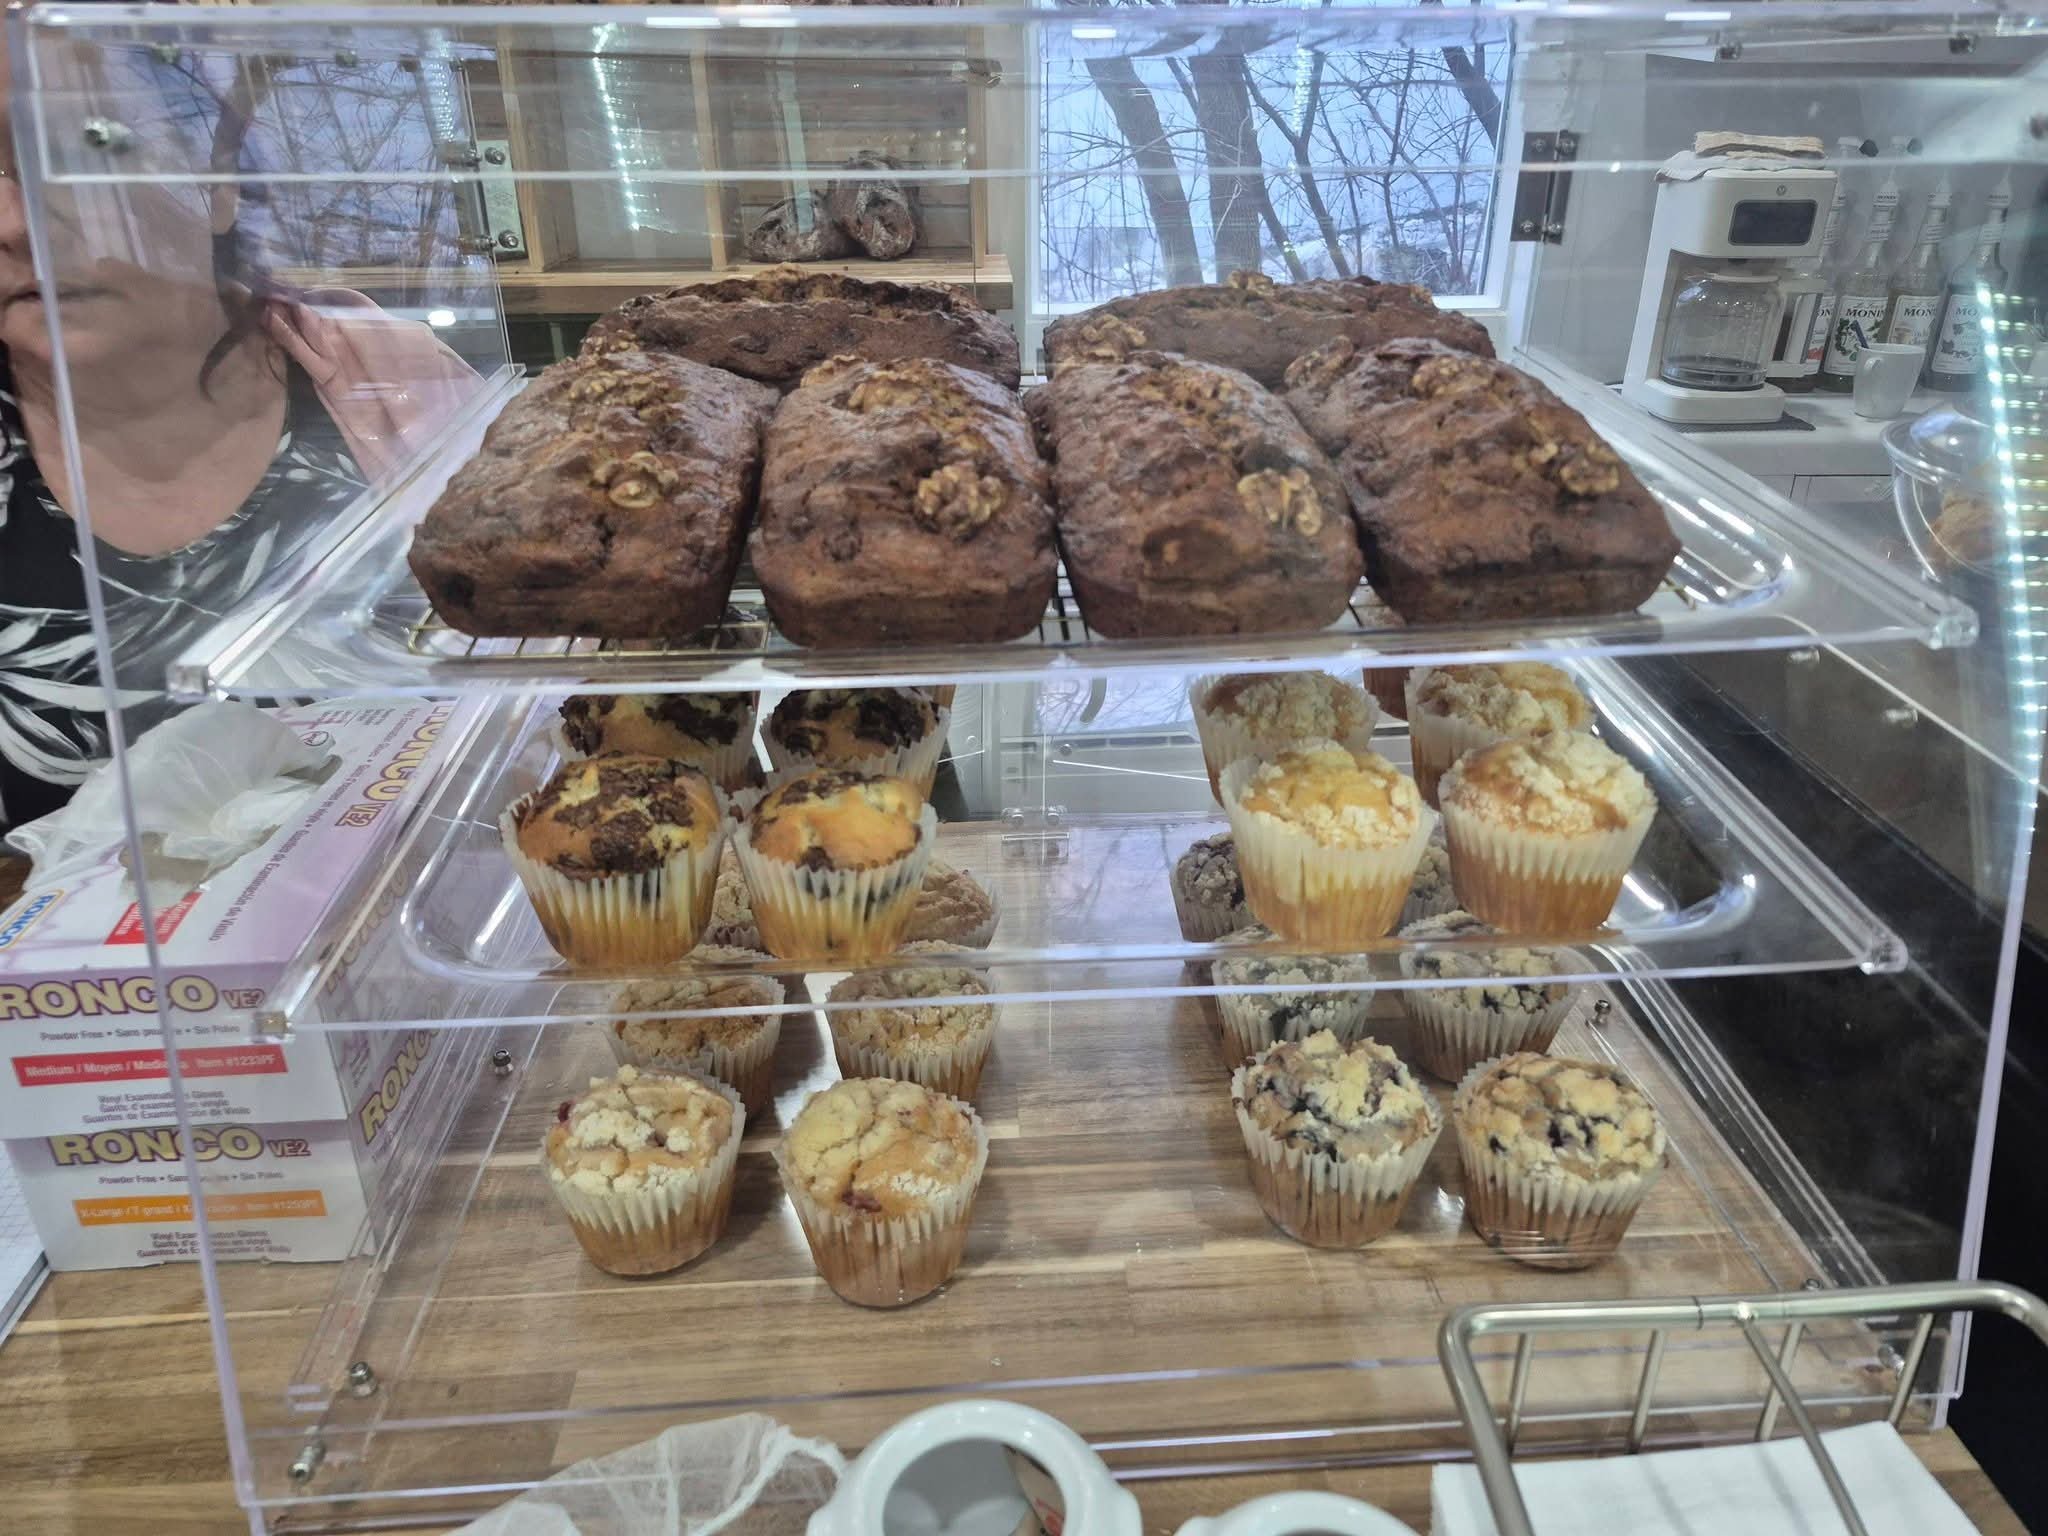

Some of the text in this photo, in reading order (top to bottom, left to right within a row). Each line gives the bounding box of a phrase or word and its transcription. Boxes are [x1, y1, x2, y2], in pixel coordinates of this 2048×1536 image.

[1845, 308, 1886, 318] MONI
[1903, 307, 1937, 318] MON
[334, 802, 387, 827] VE2
[0, 975, 267, 1021] RONCO VE2
[24, 1065, 75, 1078] Medium
[48, 1127, 312, 1166] RONCO VE2
